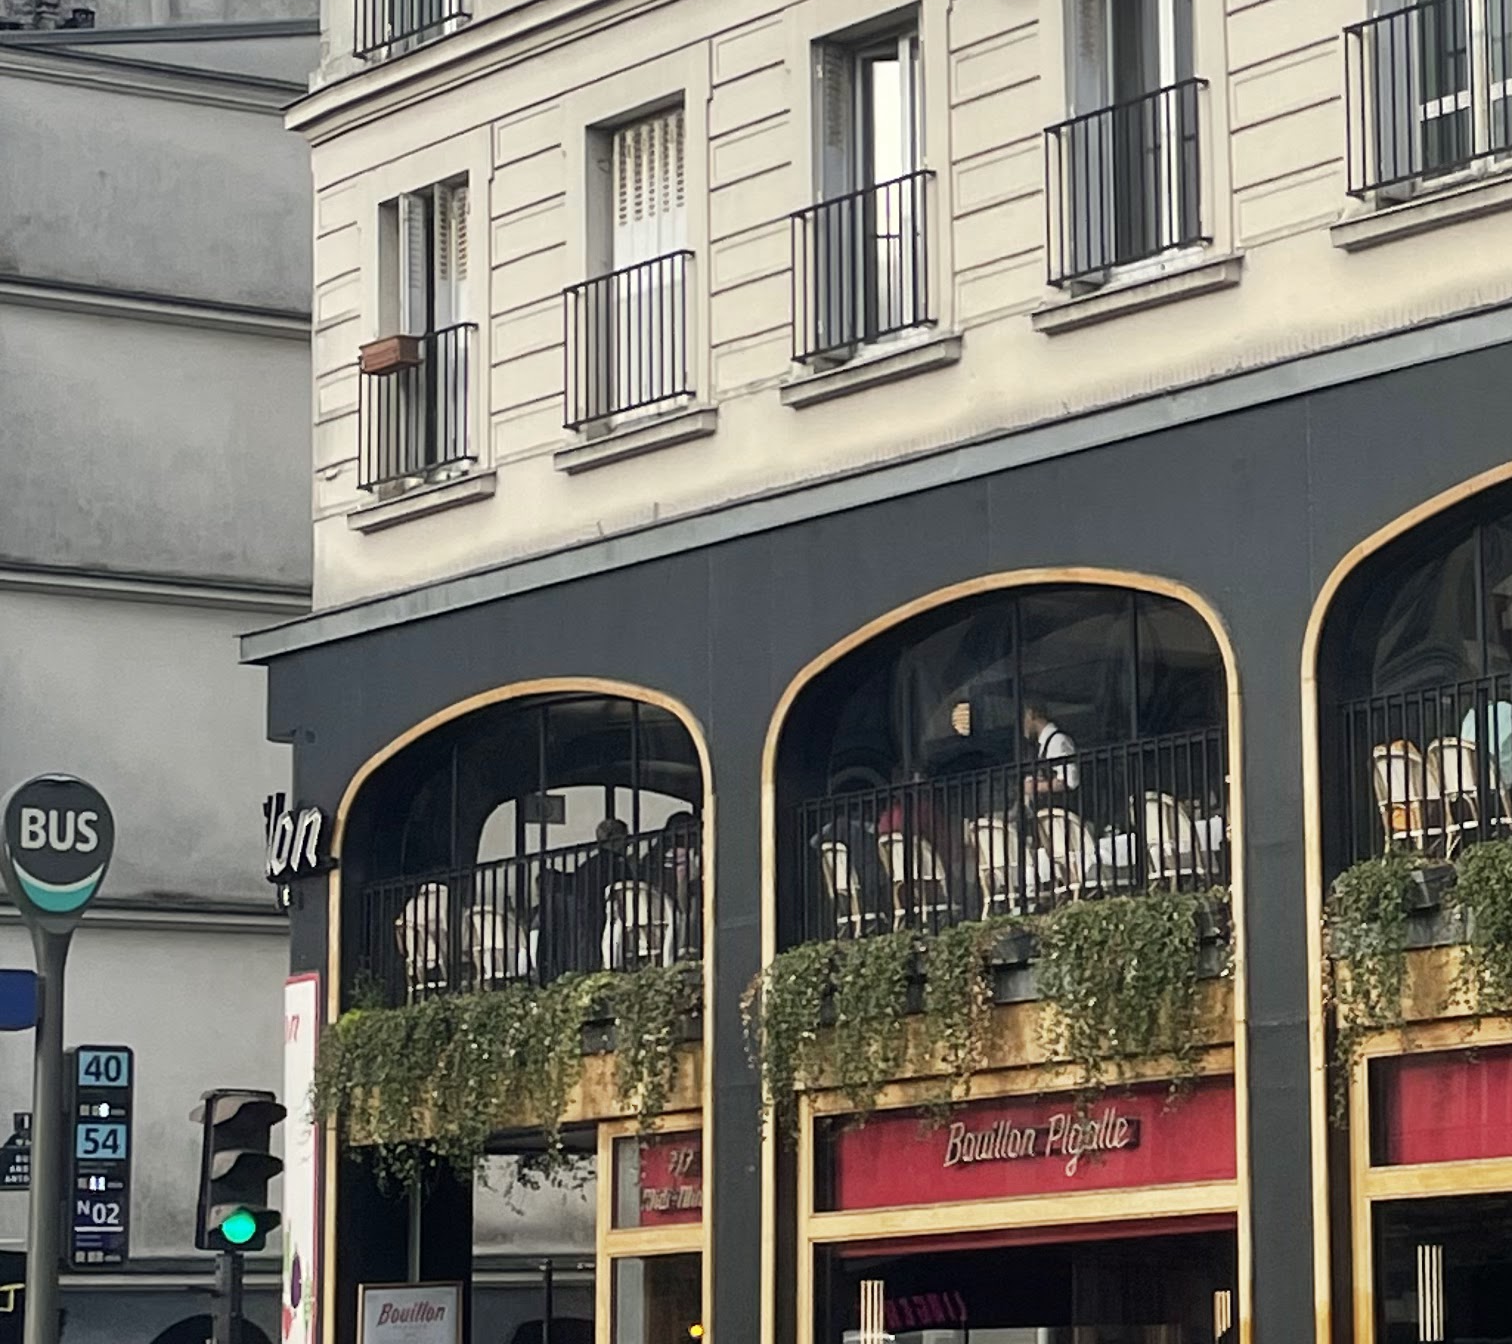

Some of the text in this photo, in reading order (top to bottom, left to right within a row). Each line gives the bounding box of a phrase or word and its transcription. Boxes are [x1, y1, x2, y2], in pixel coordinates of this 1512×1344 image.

[21, 807, 99, 853] BUS
[83, 1054, 122, 1083] 40
[82, 1127, 120, 1155] 54
[943, 1107, 1131, 1177] Bouillon Pigalle
[376, 1301, 447, 1328] Bouillon
